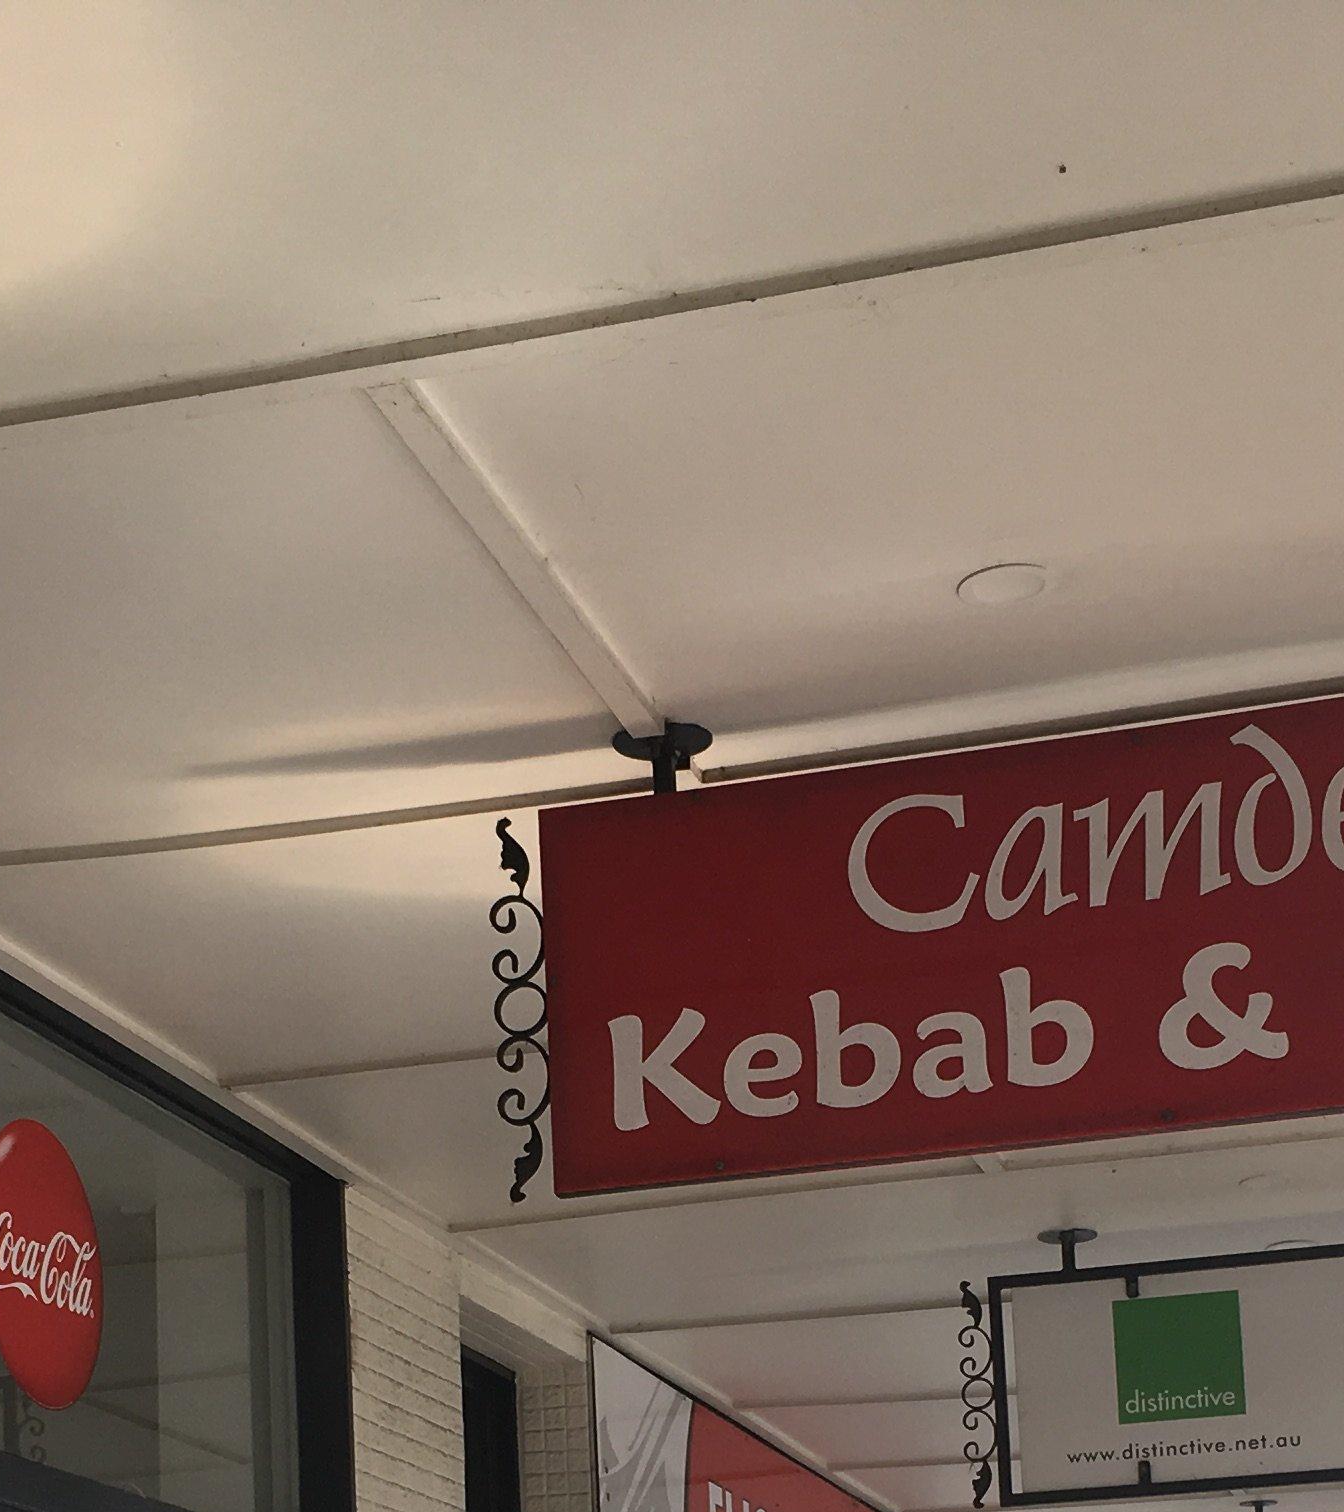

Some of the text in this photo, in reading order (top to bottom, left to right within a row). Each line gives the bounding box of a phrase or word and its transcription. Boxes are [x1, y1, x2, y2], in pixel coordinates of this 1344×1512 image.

[608, 967, 1094, 1130] Kebab
[1159, 943, 1289, 1070] &
[1125, 1387, 1236, 1414] distinctive
[1066, 1434, 1302, 1463] www.distinctive.net.au
